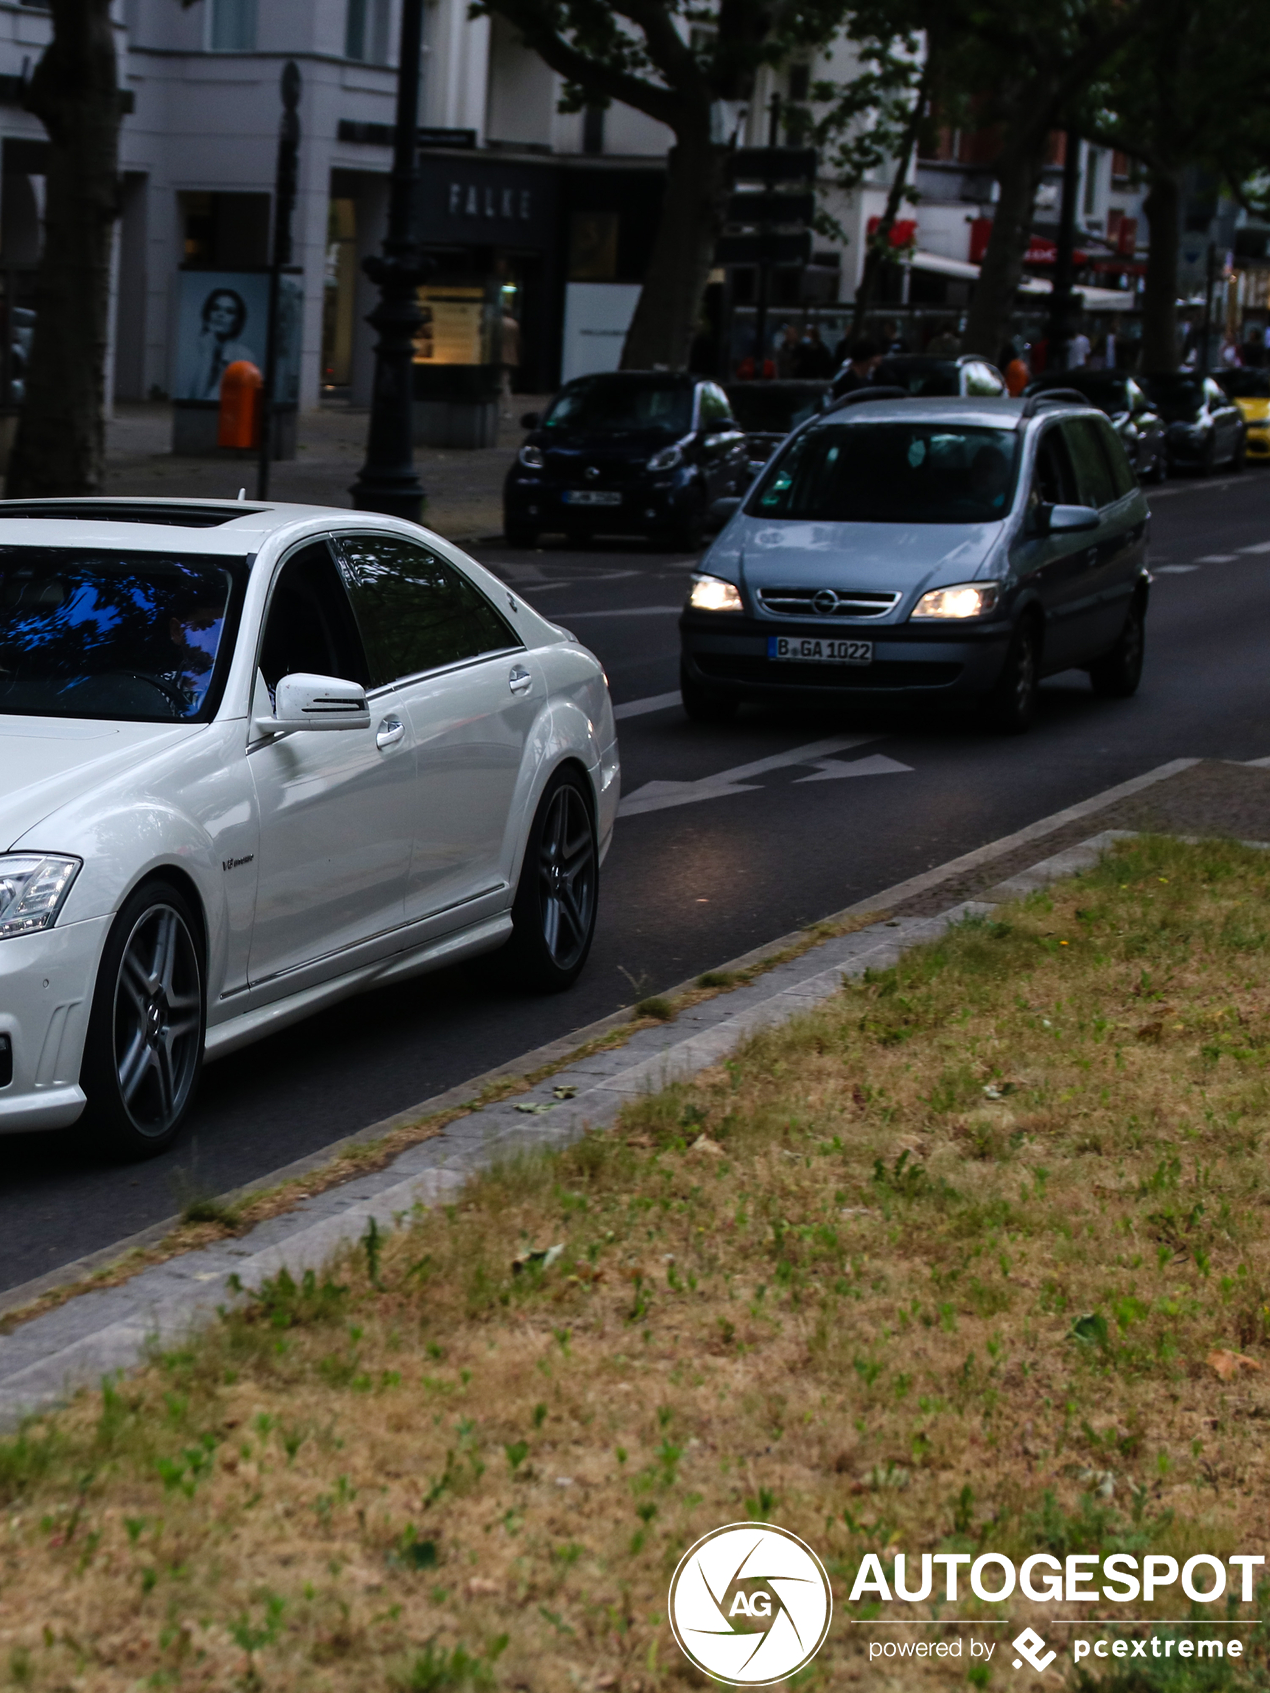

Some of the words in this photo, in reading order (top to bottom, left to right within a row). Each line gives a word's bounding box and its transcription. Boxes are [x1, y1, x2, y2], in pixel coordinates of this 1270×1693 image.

[448, 183, 530, 219] FALKE
[778, 639, 789, 655] B
[801, 640, 822, 657] GA
[827, 641, 870, 660] 1022
